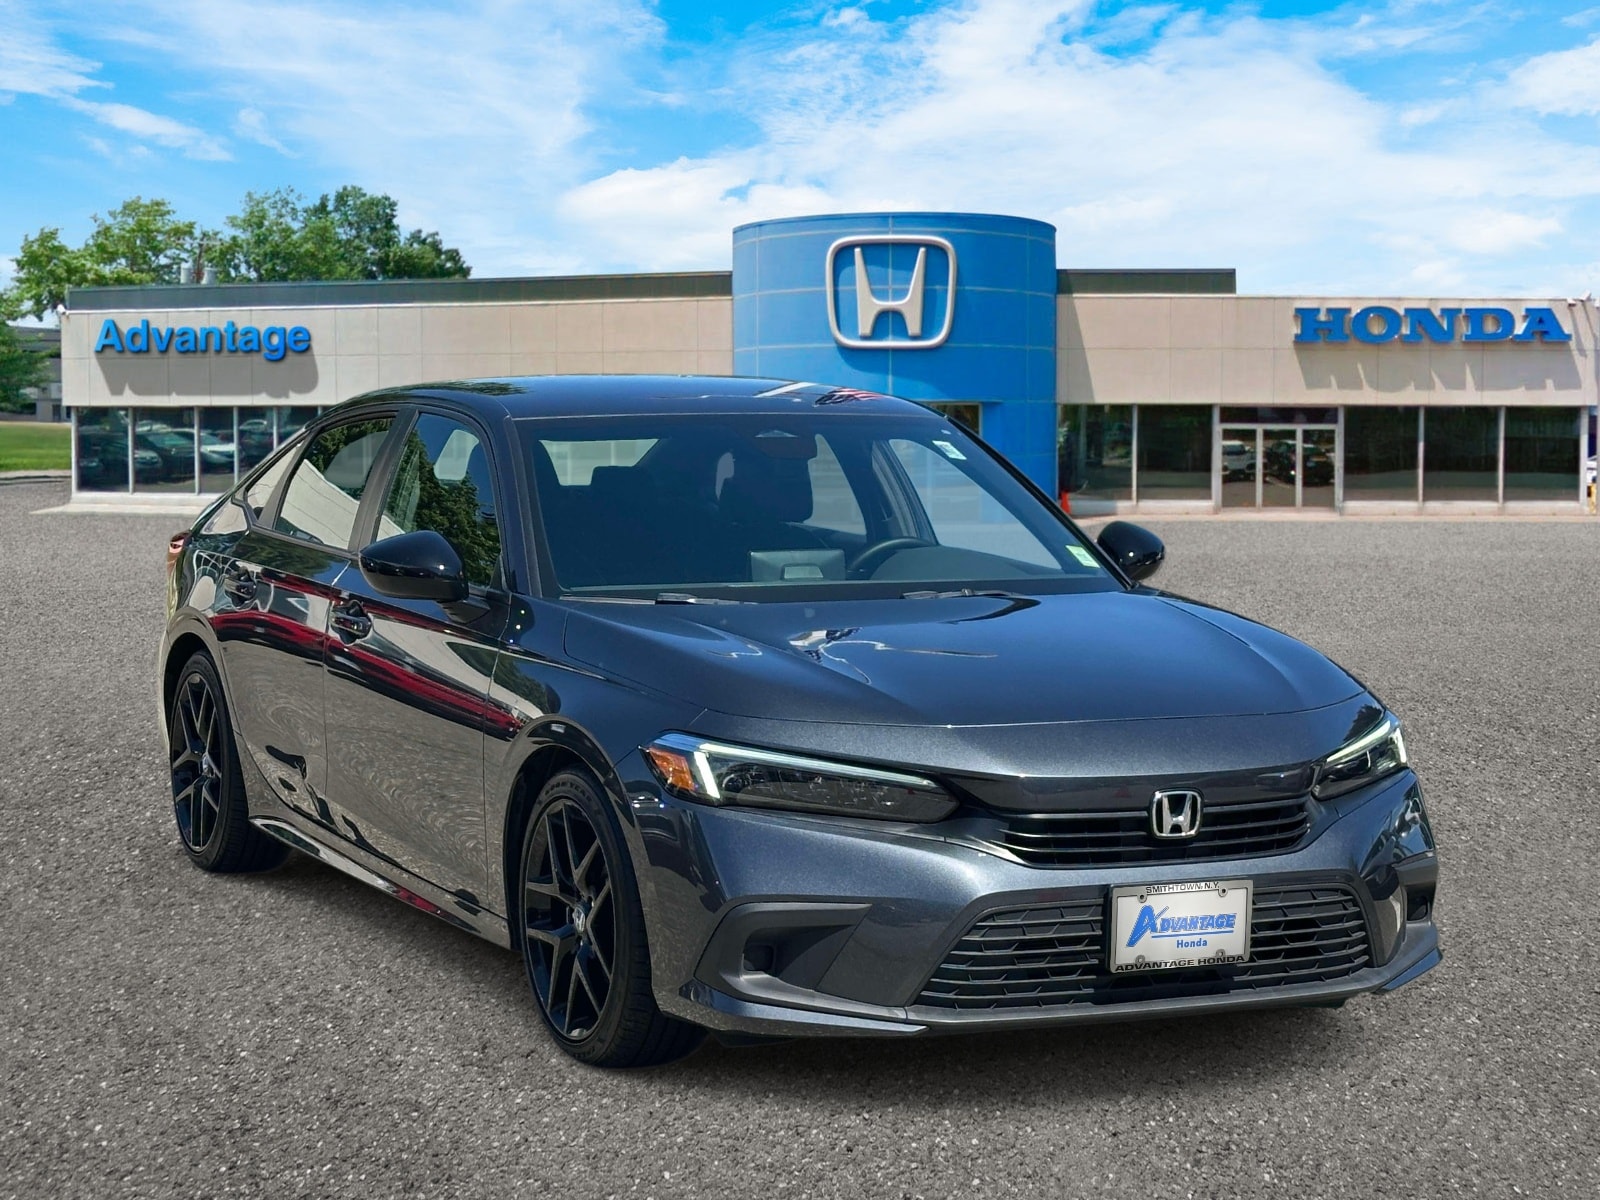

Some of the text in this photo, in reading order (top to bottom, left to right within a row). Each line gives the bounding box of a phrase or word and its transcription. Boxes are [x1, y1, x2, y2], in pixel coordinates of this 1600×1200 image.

[1293, 306, 1573, 343] HONDA
[94, 318, 312, 361] Advantage
[1176, 938, 1208, 948] Honda
[1115, 955, 1245, 972] ADVANTAGE HONDA
